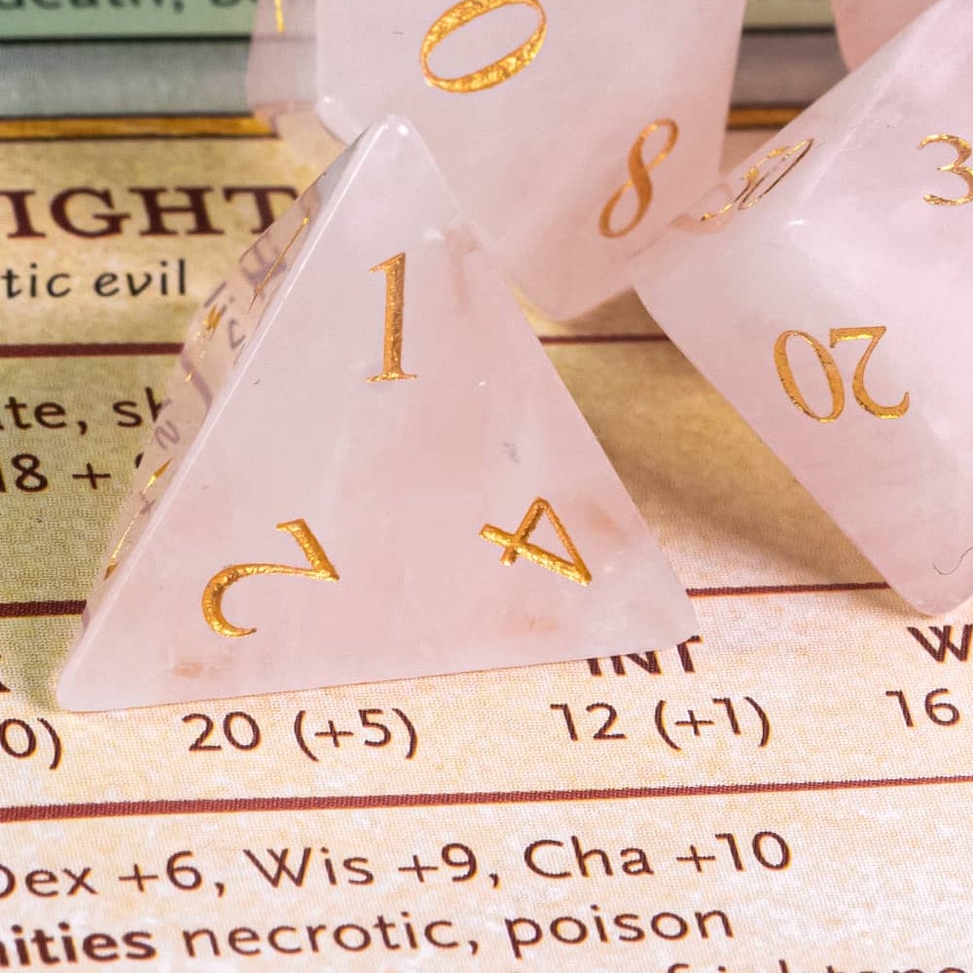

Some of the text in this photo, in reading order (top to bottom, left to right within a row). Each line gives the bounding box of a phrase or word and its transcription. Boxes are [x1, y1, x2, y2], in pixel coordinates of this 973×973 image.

[0, 184, 300, 239] IGHT
[598, 119, 679, 240] 8
[2, 258, 187, 299] tic evil
[365, 251, 418, 384] 1
[0, 396, 88, 437] te,
[200, 517, 341, 638] 2
[478, 496, 592, 585] 4
[0, 718, 62, 771] 0)
[181, 711, 262, 753] 20
[293, 708, 419, 761] (+5)
[550, 702, 628, 742] 12
[654, 695, 771, 752] (+1)
[886, 688, 961, 729] 16
[118, 850, 226, 899] +6,
[243, 845, 375, 890] Wis
[398, 842, 500, 889] +9,
[523, 835, 655, 879] Cha
[675, 829, 792, 875] +10
[182, 912, 480, 958] necrotic,
[504, 904, 734, 959] poison
